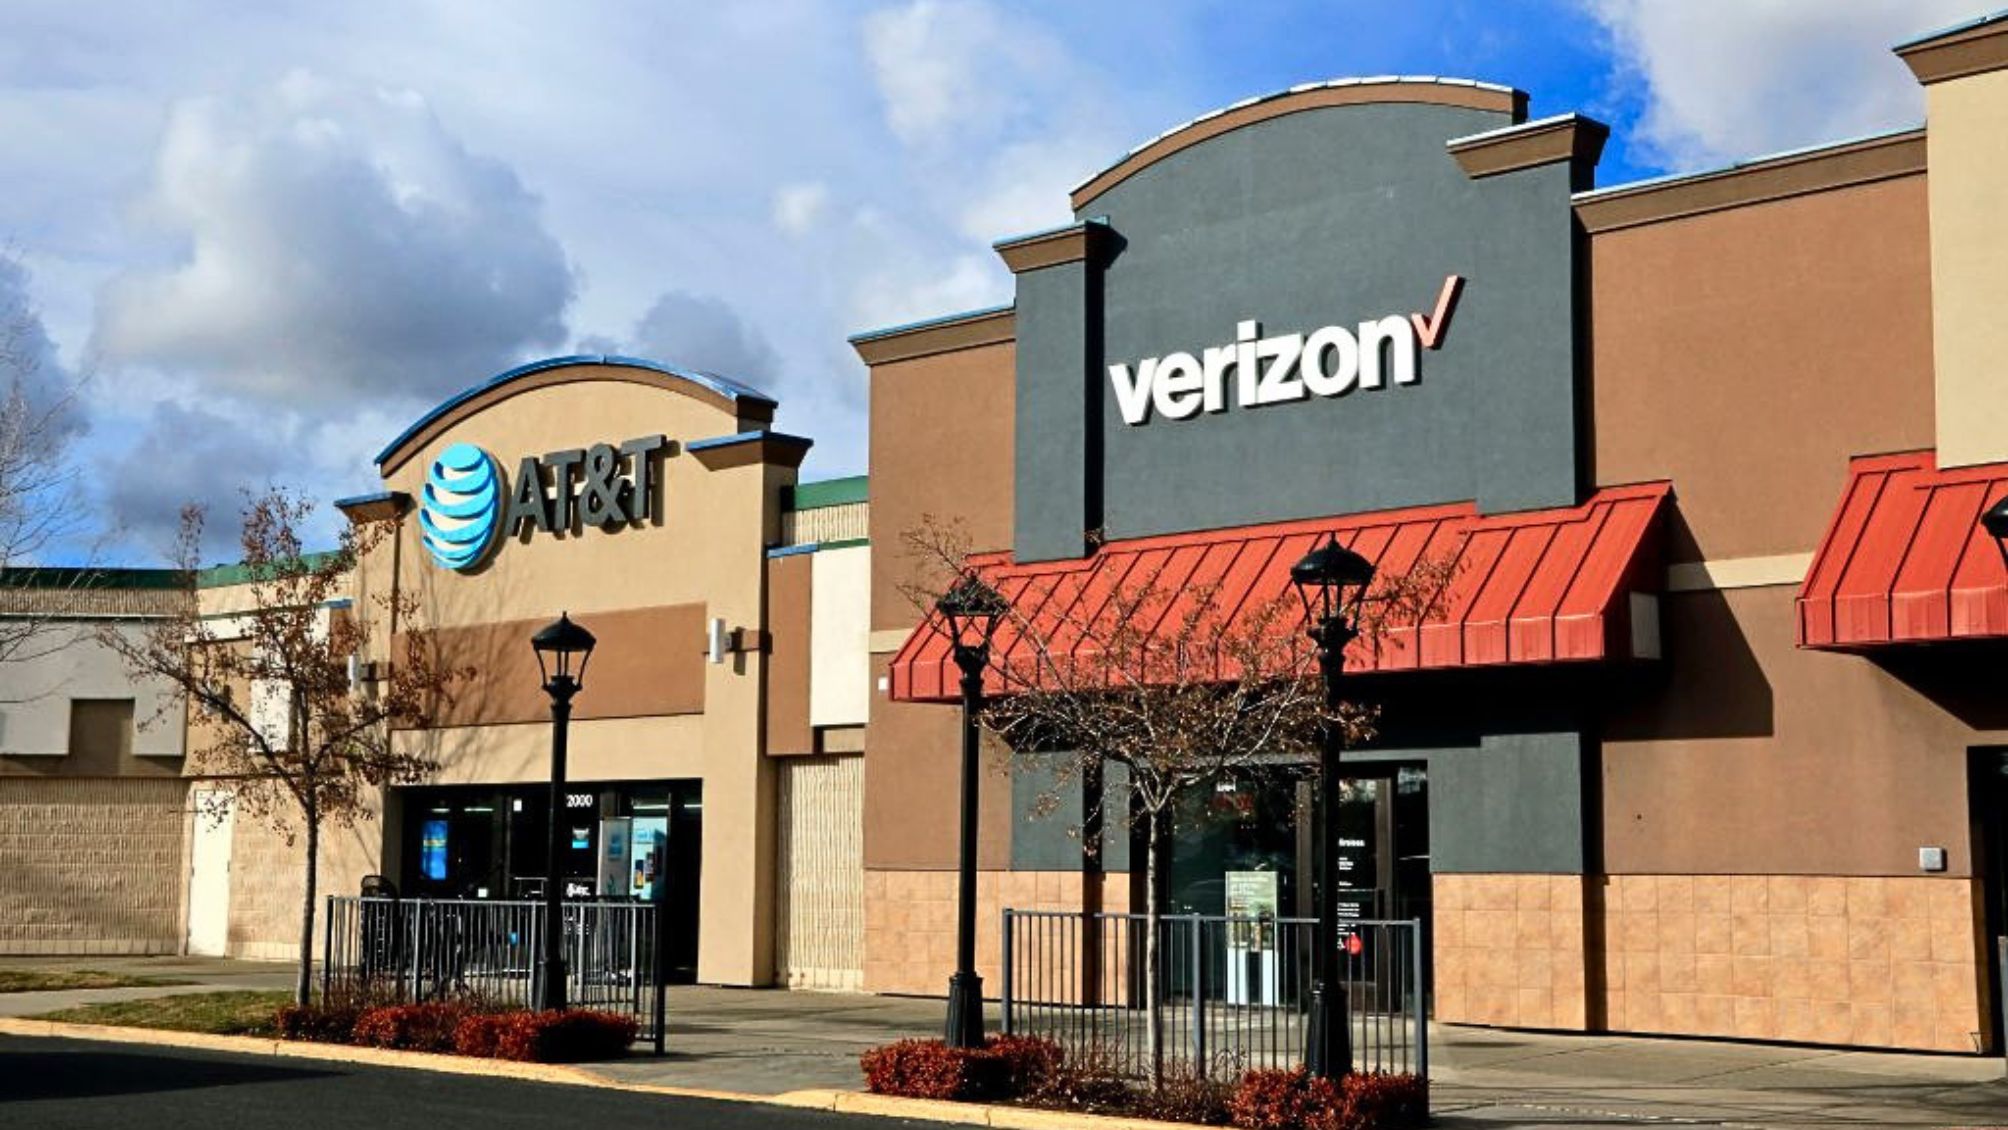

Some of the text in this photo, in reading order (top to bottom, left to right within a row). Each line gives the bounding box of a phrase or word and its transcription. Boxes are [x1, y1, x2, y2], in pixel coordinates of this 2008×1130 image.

[1108, 314, 1418, 425] verizon
[503, 434, 667, 537] AT&T
[566, 793, 593, 808] 2000
